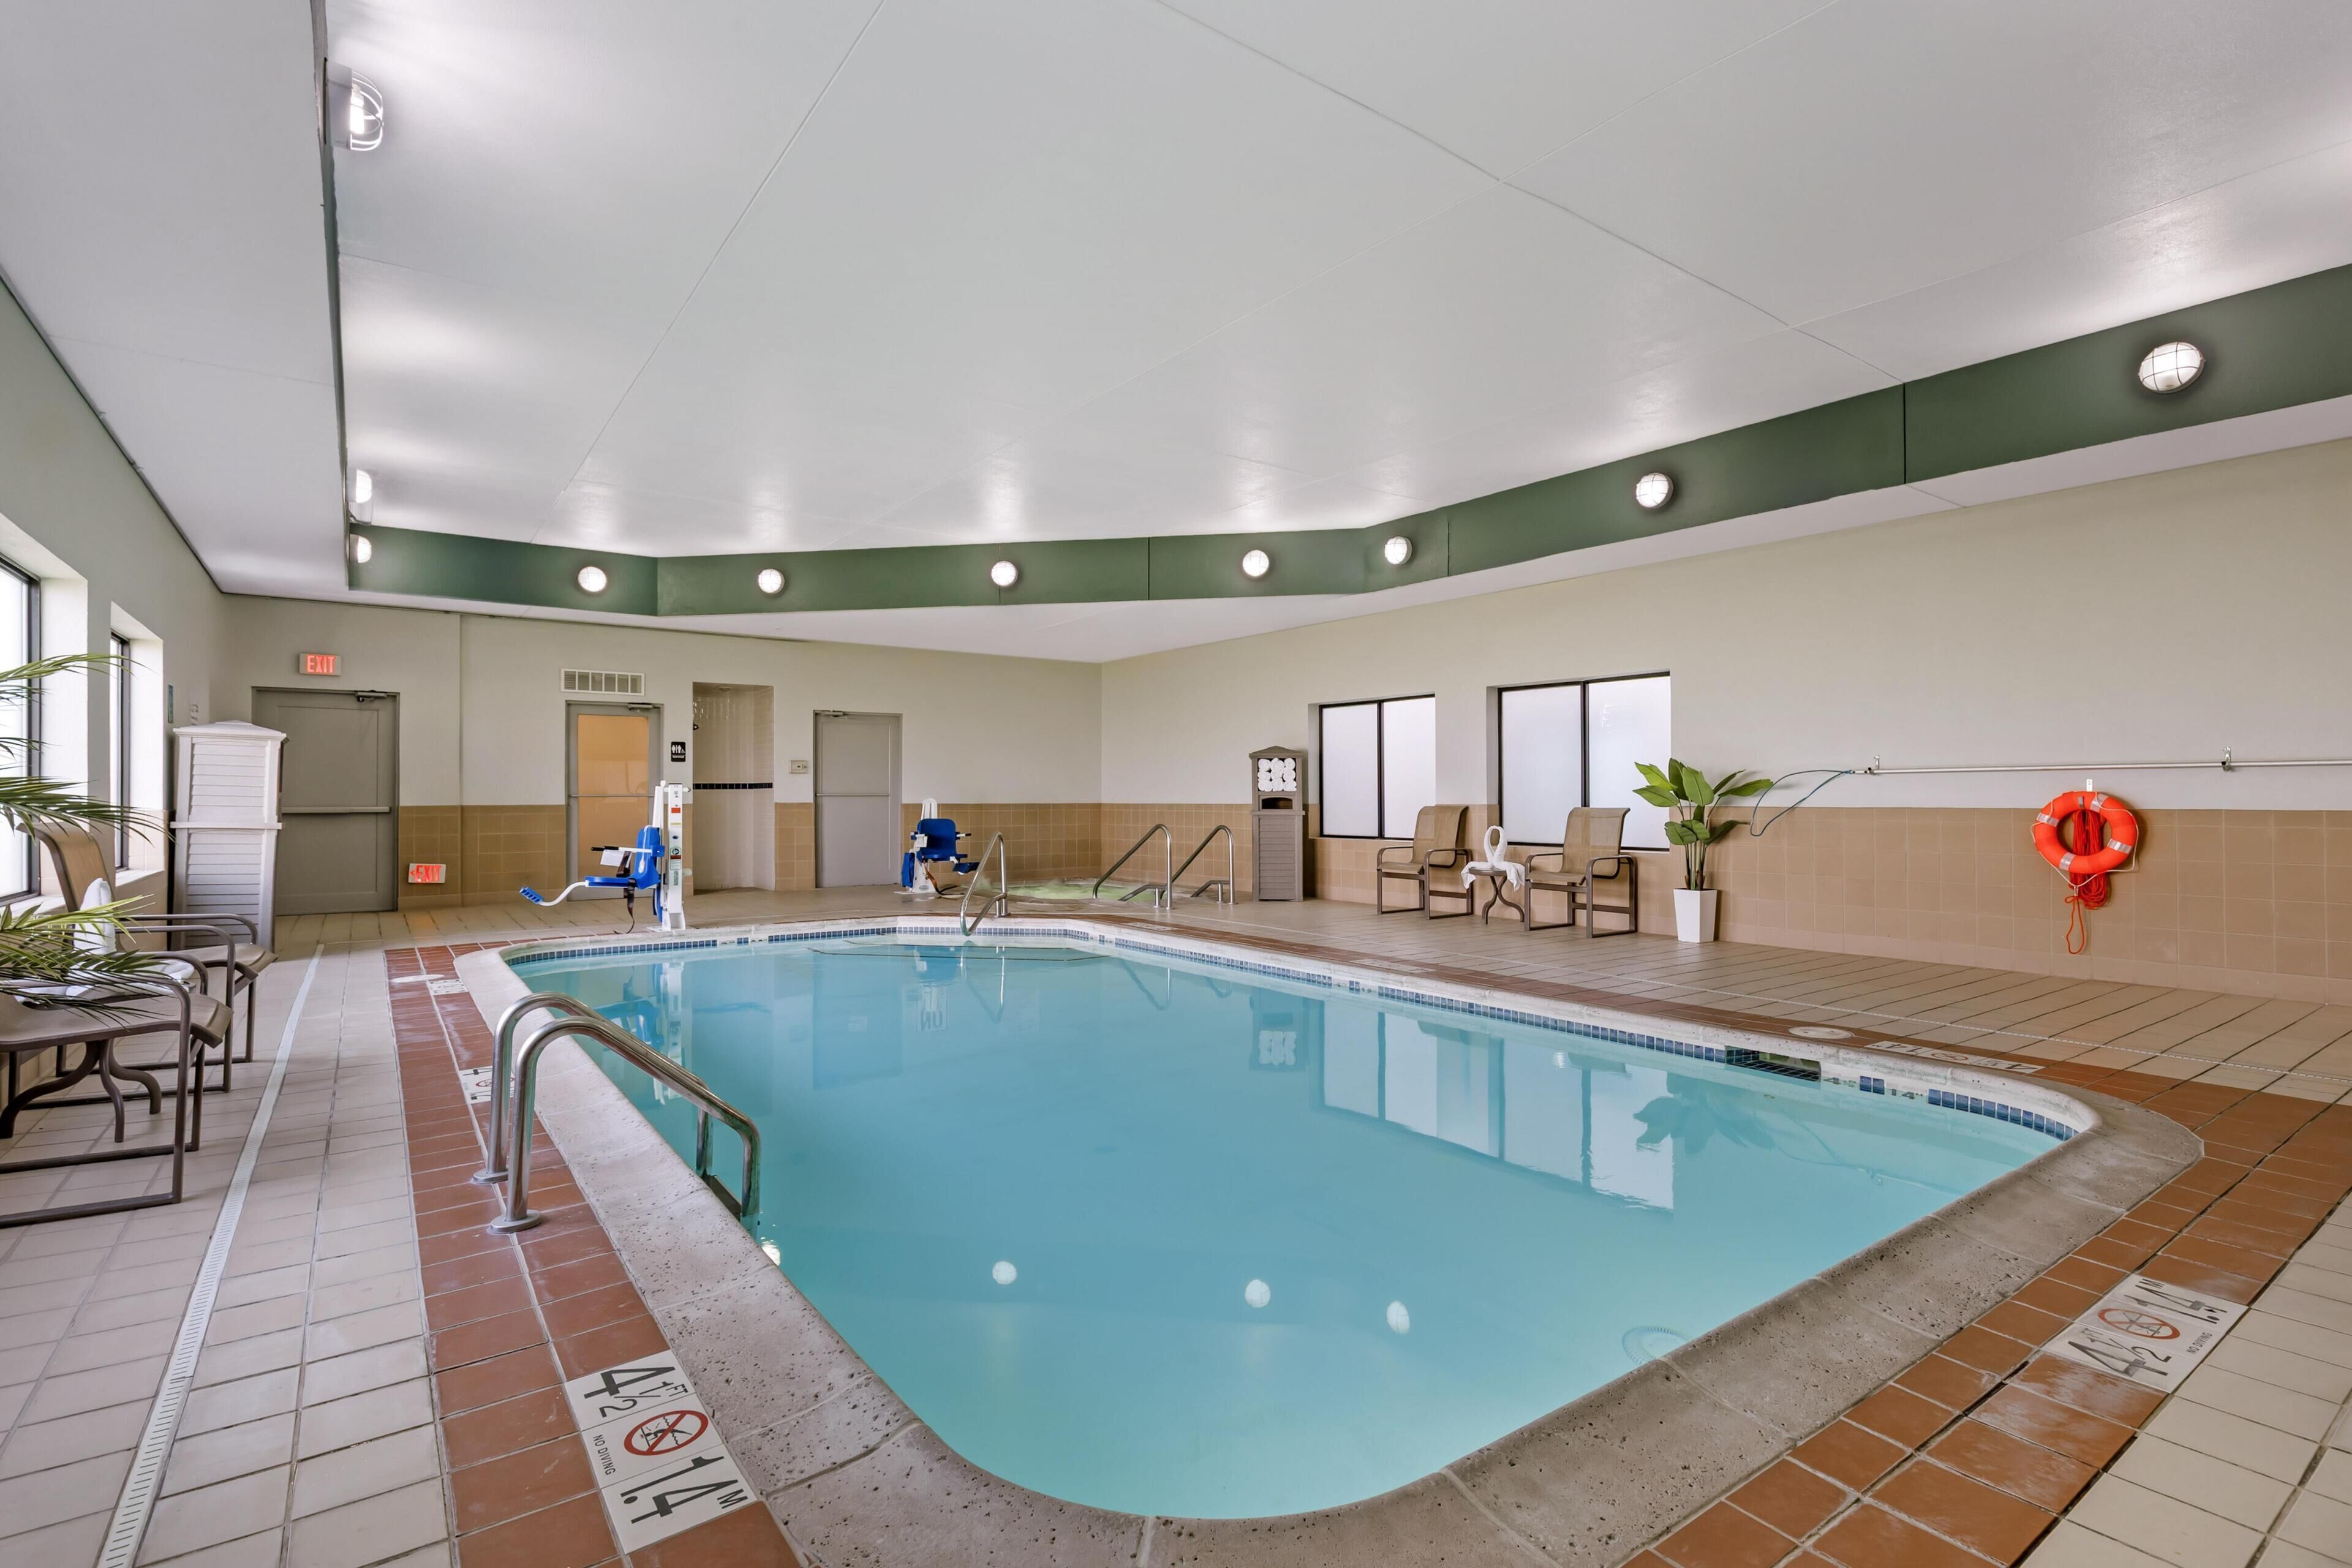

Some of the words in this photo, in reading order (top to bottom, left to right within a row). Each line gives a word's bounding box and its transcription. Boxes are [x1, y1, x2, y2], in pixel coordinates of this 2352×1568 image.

[307, 655, 335, 673] EXIT
[415, 864, 441, 882] EXIT
[2124, 1284, 2227, 1324] 1.4
[2186, 1343, 2200, 1355] NO
[2196, 1332, 2213, 1348] DIVING
[665, 1383, 688, 1397] FT
[593, 1434, 606, 1447] NO
[597, 1447, 616, 1476] DIVING
[620, 1455, 739, 1525] 1.4
[717, 1488, 748, 1510] M
